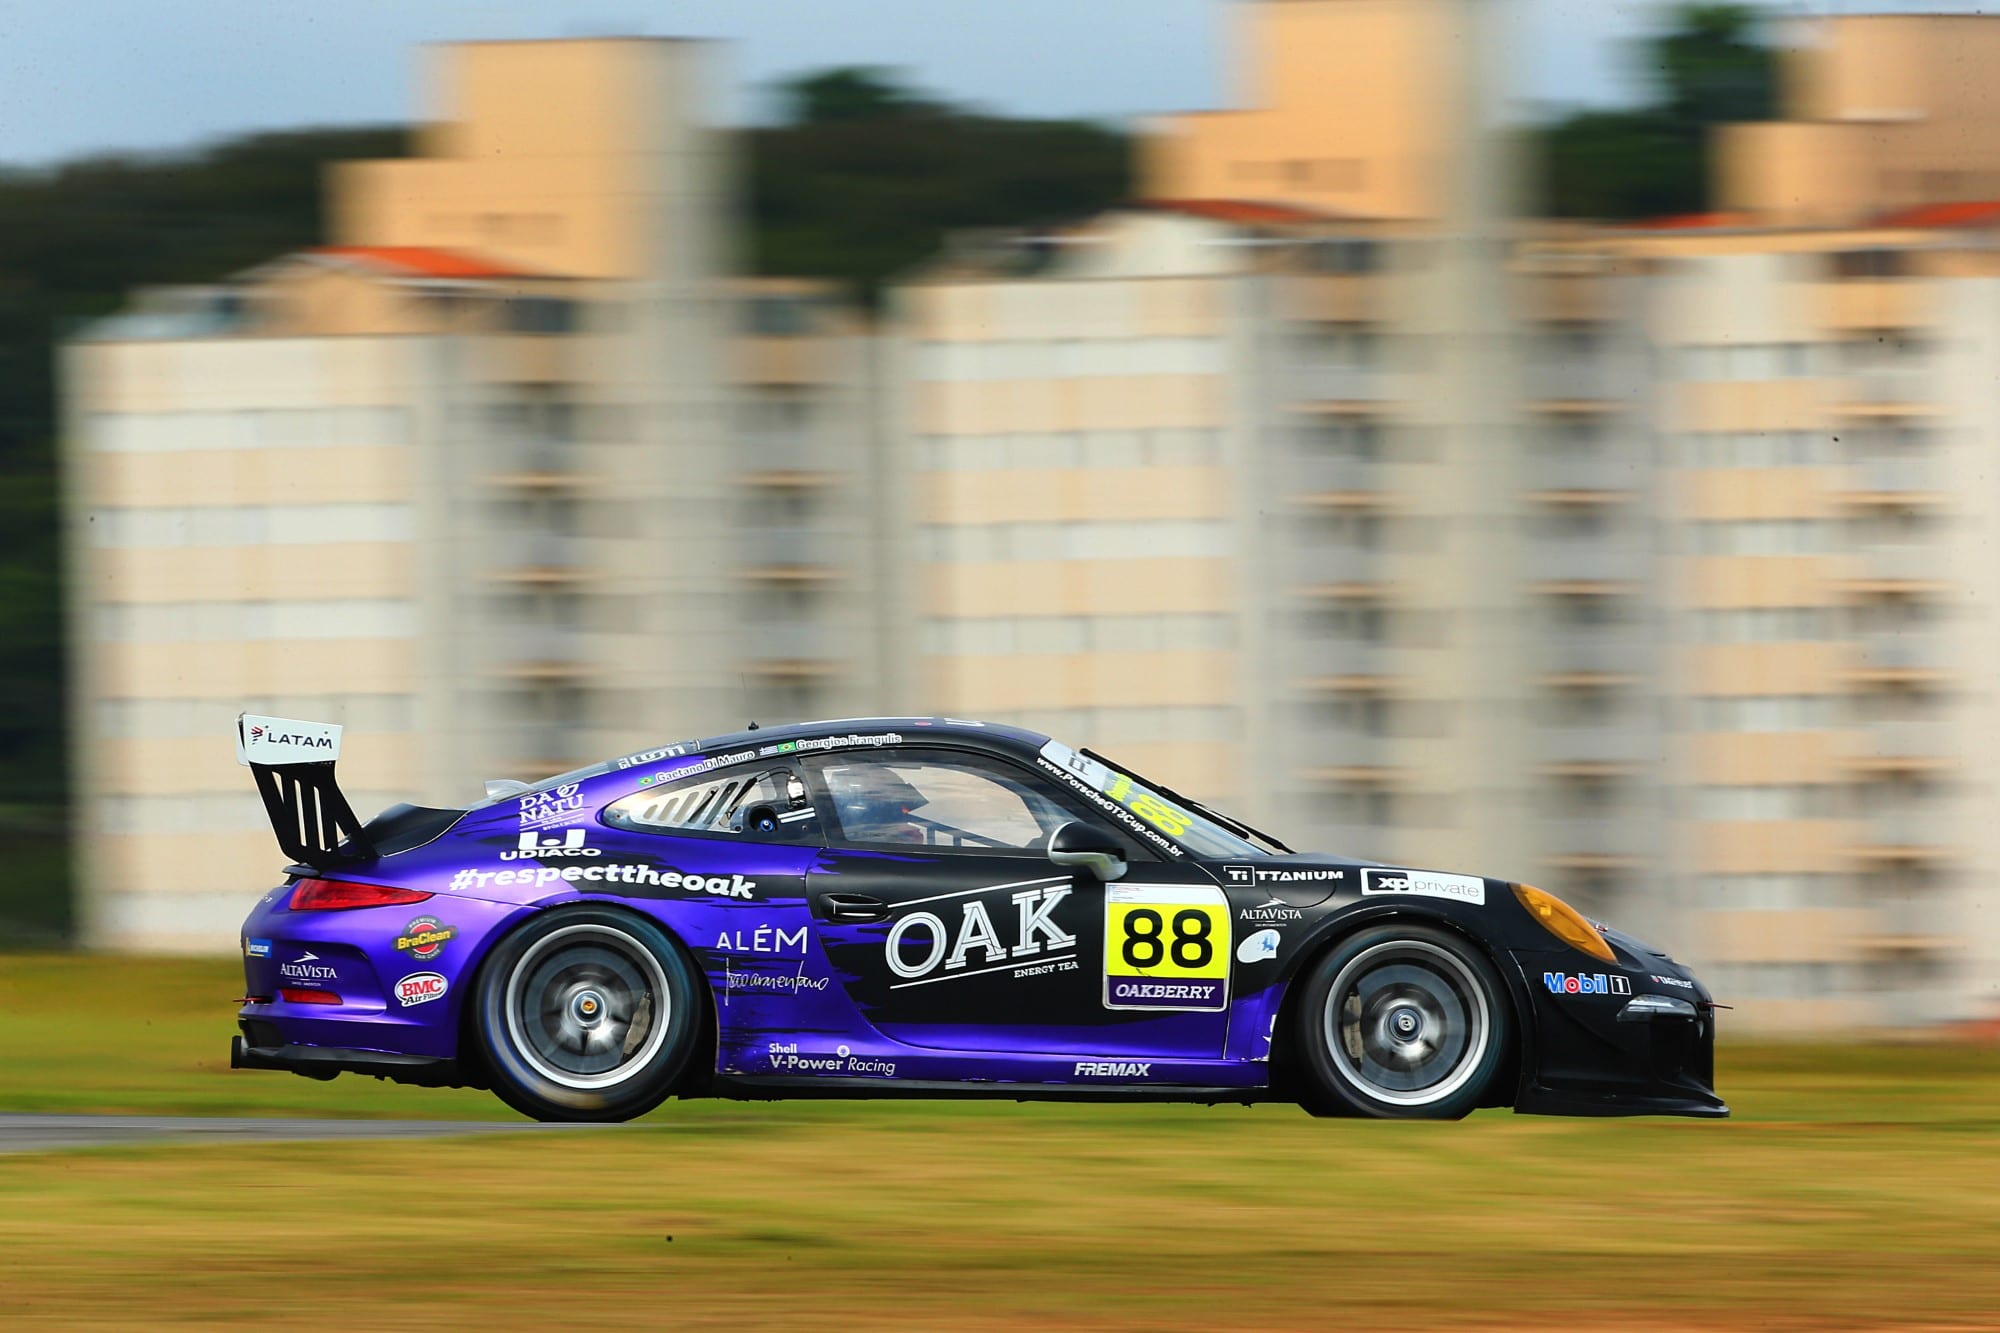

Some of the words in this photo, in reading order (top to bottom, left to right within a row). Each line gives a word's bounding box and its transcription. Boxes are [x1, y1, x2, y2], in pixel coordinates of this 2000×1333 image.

[267, 732, 333, 749] LATAM
[797, 737, 848, 750] Georgios
[848, 732, 902, 748] Frangulis
[655, 762, 704, 783] Gaetano
[704, 757, 718, 772] Di
[718, 751, 756, 767] Mauro
[519, 794, 584, 824] NATU
[520, 793, 554, 810] DA
[1036, 757, 1184, 857] www.PorscheGT3Cup.com.br
[449, 864, 756, 899] #respecttheoak
[1414, 878, 1480, 898] private
[397, 930, 451, 950] BraClean
[716, 923, 808, 954] ALÉM
[885, 884, 1076, 978] OAK
[1122, 908, 1213, 968] 88
[1014, 964, 1055, 978] ENERGY
[1057, 961, 1079, 971] TEA
[401, 978, 443, 997] BMC
[1115, 983, 1215, 1000] OAKBERRY
[1543, 972, 1609, 994] Mobil
[405, 994, 422, 1005] Air
[769, 1043, 798, 1054] Shell
[769, 1054, 844, 1070] V-Power
[847, 1057, 896, 1076] Racing
[1074, 1062, 1152, 1077] FREMAX
